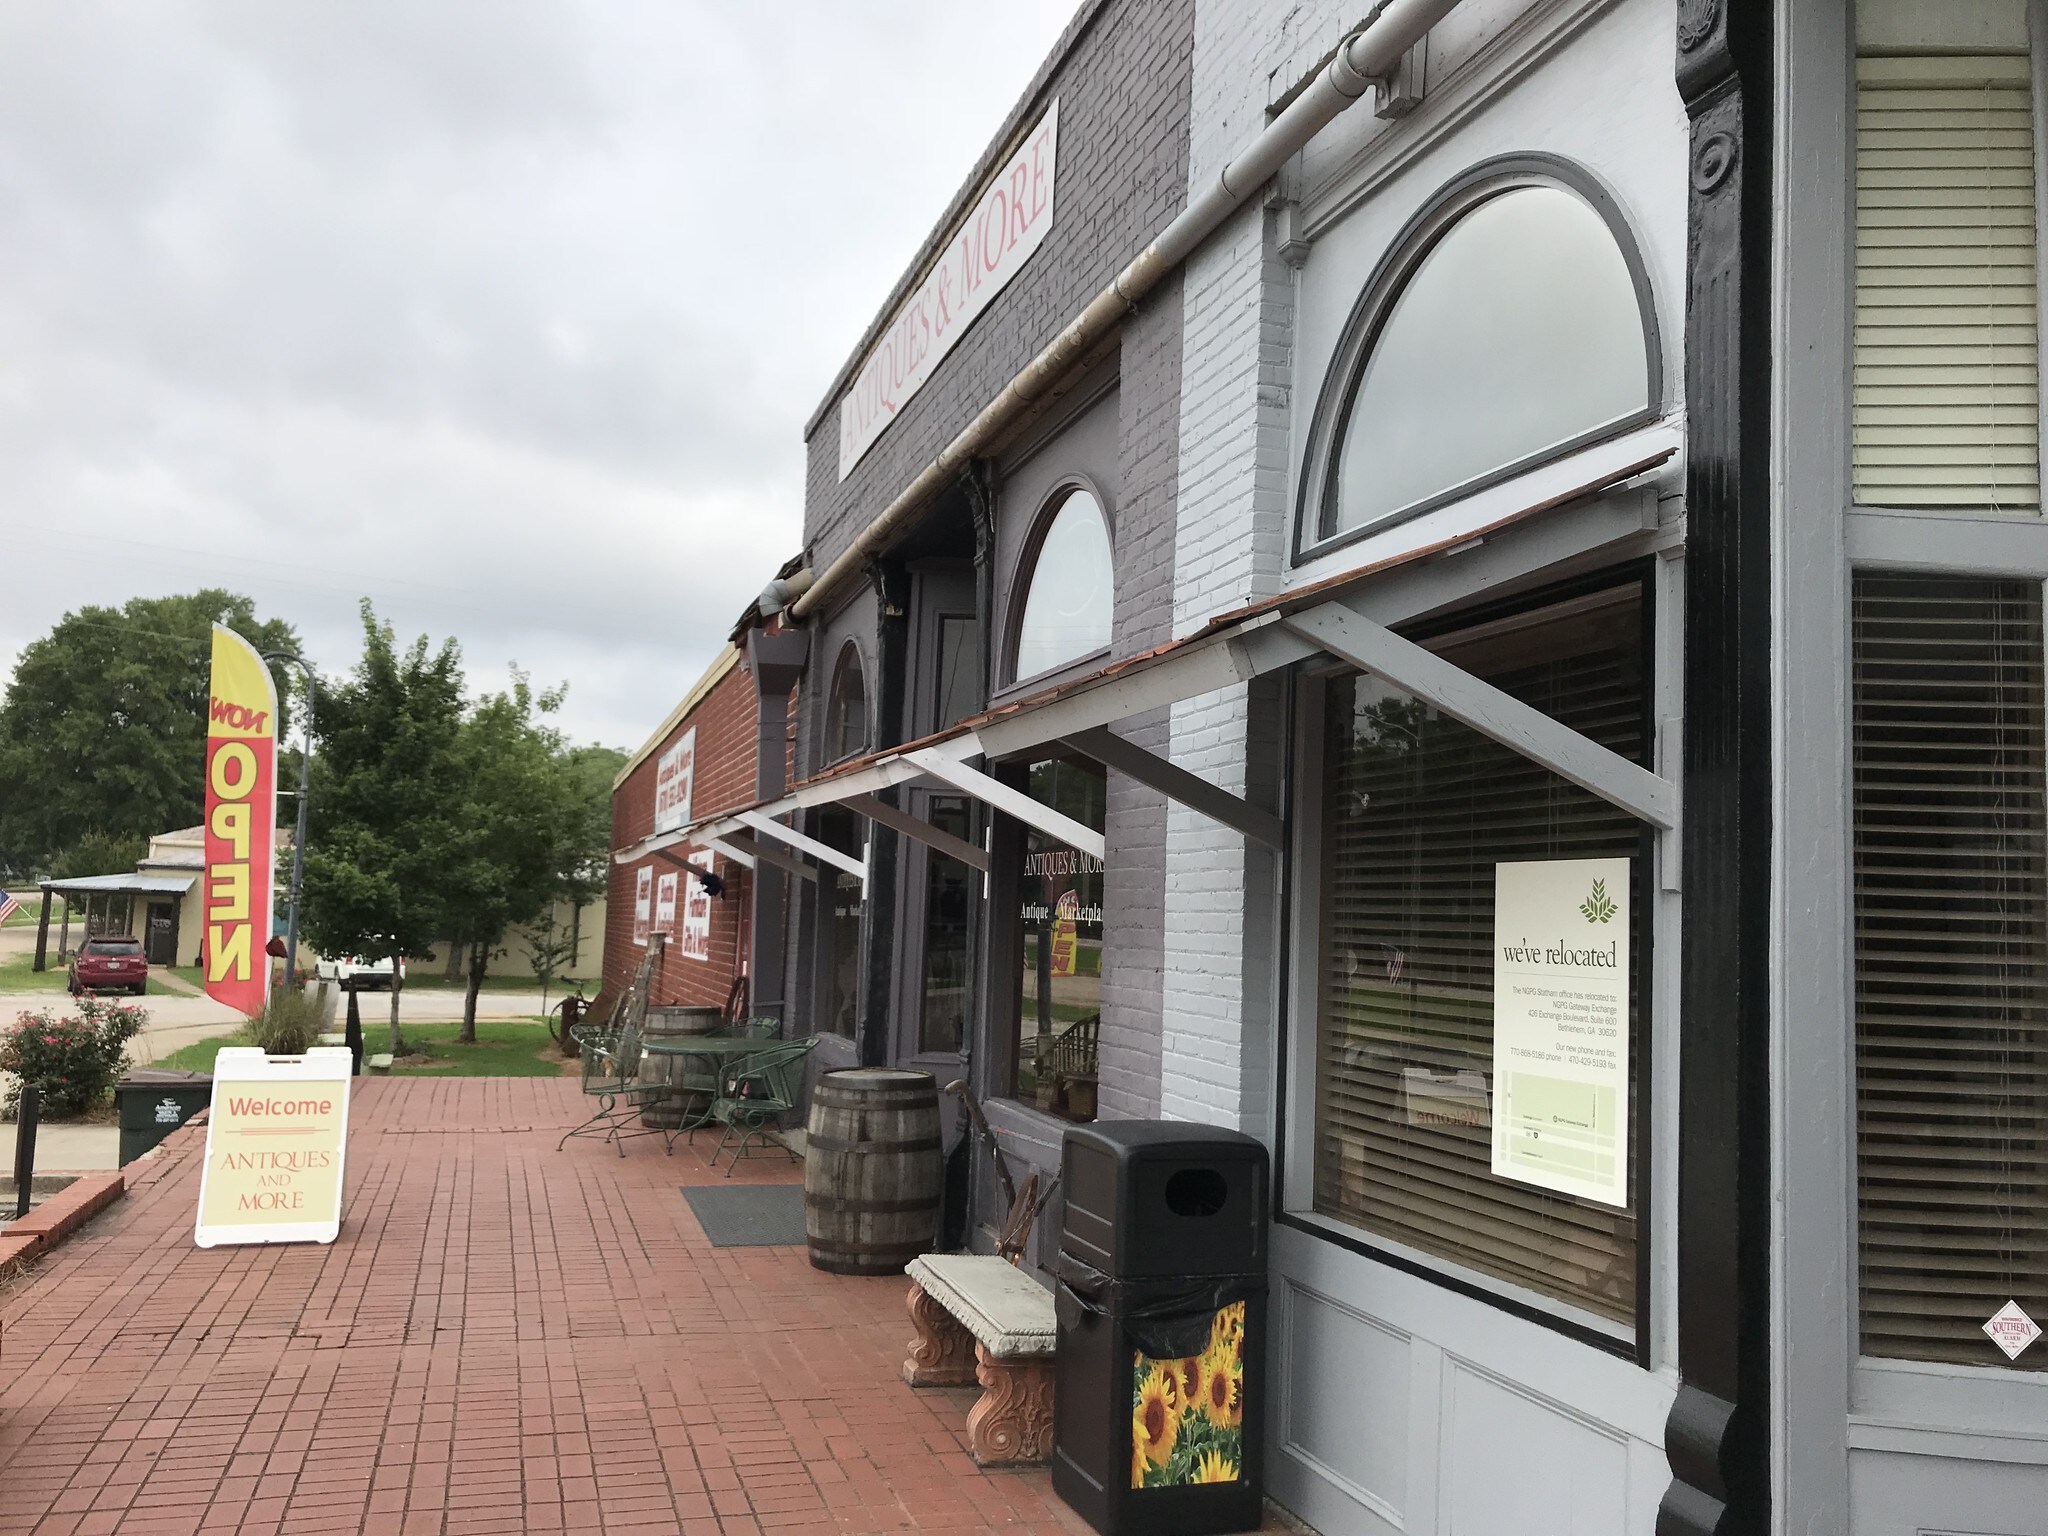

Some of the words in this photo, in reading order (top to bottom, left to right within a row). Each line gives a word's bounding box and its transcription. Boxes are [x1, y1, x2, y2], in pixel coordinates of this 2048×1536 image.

[842, 287, 931, 461] ANTIQUES
[936, 264, 952, 338] &
[959, 126, 1050, 309] MORE
[1024, 851, 1069, 880] ANTIQUES
[1070, 850, 1078, 875] &
[1020, 902, 1049, 924] Antique
[1503, 937, 1541, 963] we've
[1545, 939, 1617, 967] relocated
[1512, 985, 1521, 994] The
[1558, 989, 1573, 999] office
[1574, 991, 1583, 999] has
[1584, 992, 1609, 1001] relocated
[1552, 1001, 1568, 1010] NGPG
[1568, 1002, 1590, 1013] Gateway
[1591, 1004, 1617, 1015] Exchange
[1538, 1010, 1562, 1021] Exchange
[1590, 1015, 1604, 1024] Suite
[1605, 1017, 1617, 1026] 600
[1587, 1027, 1595, 1035] GA
[1598, 1028, 1617, 1038] 30620
[1555, 1042, 1565, 1051] Our
[1577, 1046, 1594, 1056] phone
[1595, 1048, 1606, 1057] and
[1546, 1053, 1561, 1062] phone
[1607, 1061, 1616, 1070] fax
[229, 1098, 332, 1116] Welcome
[221, 1151, 331, 1172] ANTIQUES
[257, 1174, 291, 1187] AND
[238, 1192, 304, 1210] MORE
[1992, 1321, 2032, 1337] SOUTHERN
